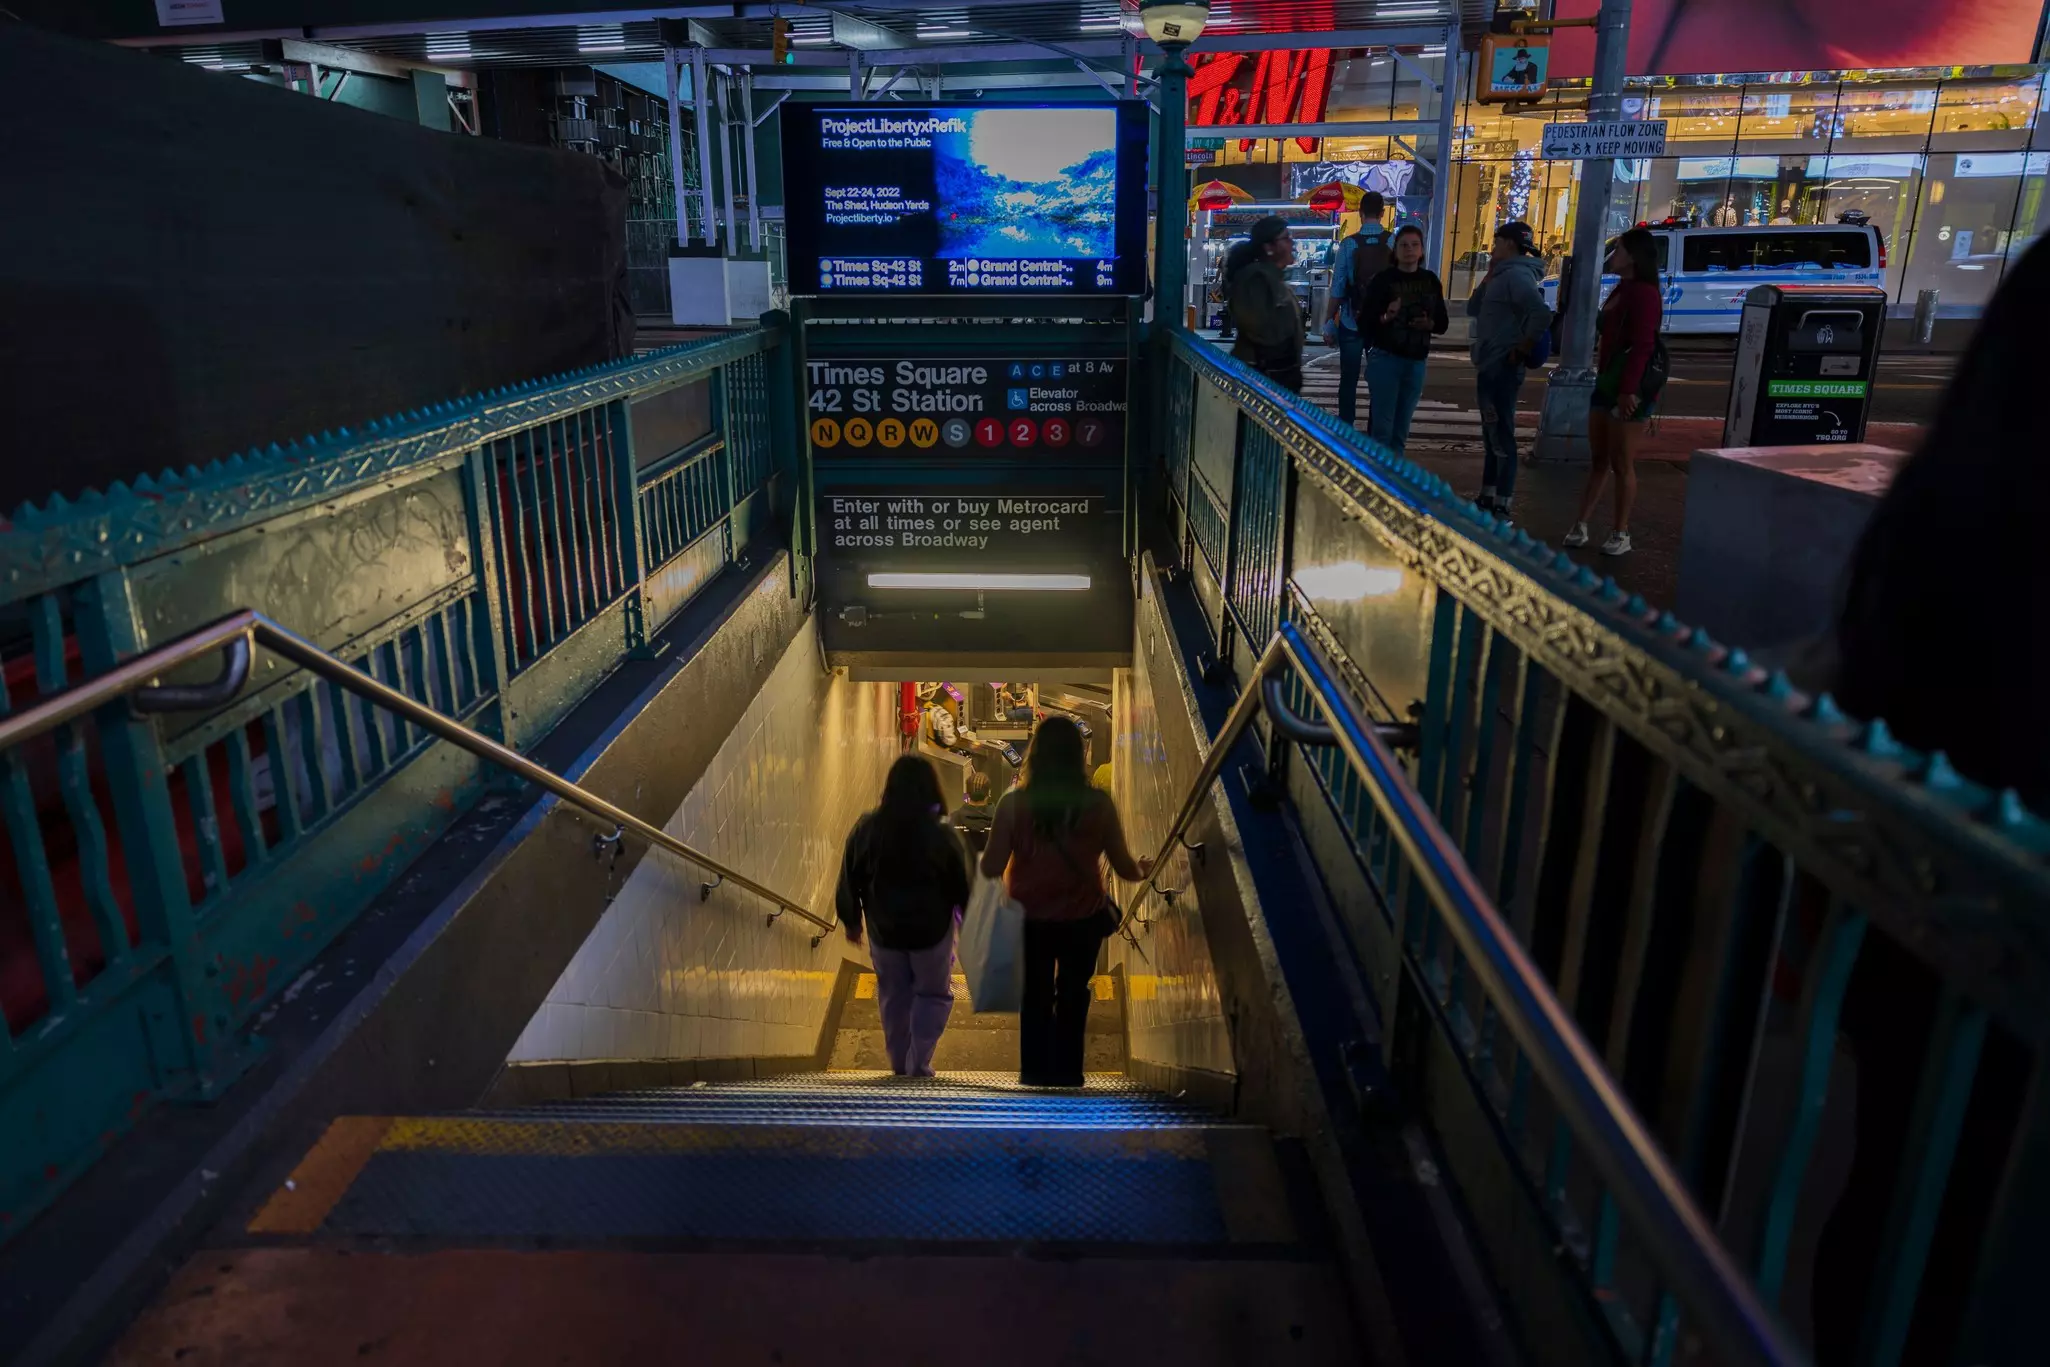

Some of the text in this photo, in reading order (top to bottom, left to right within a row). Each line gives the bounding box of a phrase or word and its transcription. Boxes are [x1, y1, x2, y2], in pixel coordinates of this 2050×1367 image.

[821, 118, 967, 136] ProjectLibertyxRefik
[1545, 121, 1665, 139] PEDESTRIAN FLOW ZONE
[822, 137, 932, 150] Free & Open to the Public
[1595, 141, 1663, 155] KEEP MOVING
[824, 187, 900, 199] Sept 22-24, 2022
[825, 200, 844, 210] The
[870, 200, 905, 210] Hudson
[826, 213, 893, 225] Projectliberty.io
[833, 260, 922, 274] Times Sq-42 St
[949, 260, 965, 272] 2m
[980, 260, 1017, 272] Grand
[1096, 260, 1113, 272] 4m
[834, 274, 922, 288] Times Sq-42 St
[949, 274, 965, 286] 7m
[980, 274, 1017, 286] Grand
[1068, 363, 1081, 374] at
[1085, 362, 1095, 374] 8
[1099, 362, 1114, 374] Av
[806, 361, 988, 389] Times Square
[1029, 388, 1079, 400] Elevator
[1771, 384, 1864, 395] TIMES SQUARE
[808, 389, 984, 413] 42 St Station
[1029, 400, 1128, 412] across Broadwa
[833, 499, 1089, 517] Enter with or buy Metrocard
[834, 516, 1060, 534] at all times or see agent
[835, 532, 989, 549] across Broadway
